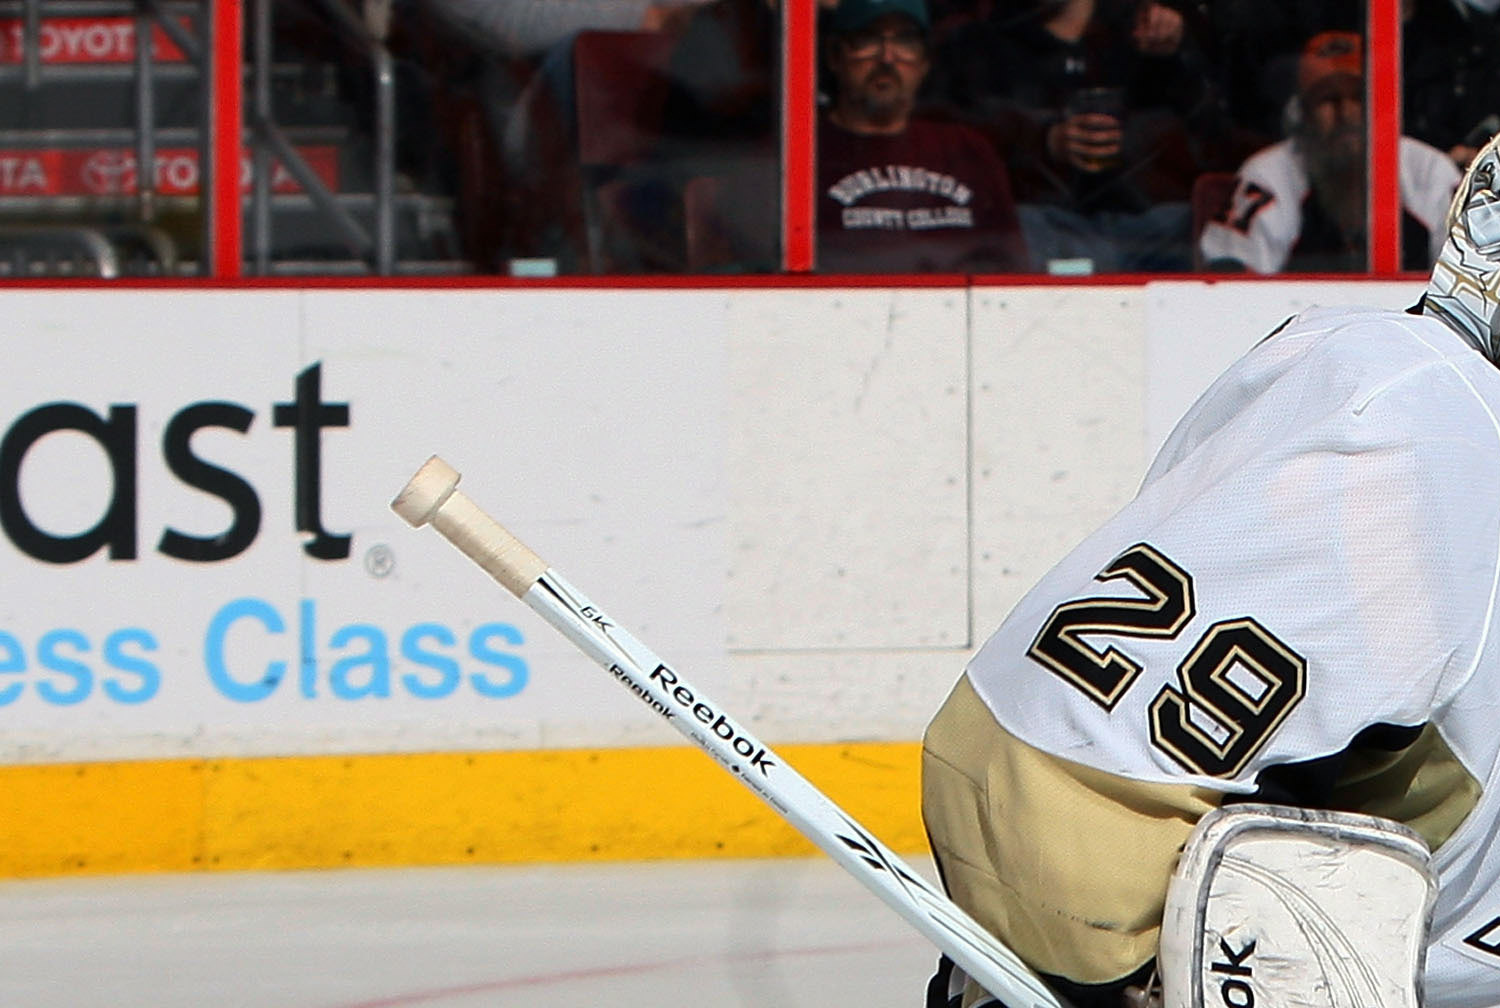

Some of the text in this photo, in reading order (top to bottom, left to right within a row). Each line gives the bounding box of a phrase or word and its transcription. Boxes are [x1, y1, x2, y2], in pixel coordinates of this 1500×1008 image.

[12, 23, 156, 57] TOYOT
[204, 598, 530, 702] Class
[609, 663, 677, 721] Reebok
[1025, 541, 1308, 779] 29
[649, 663, 777, 778] Reebok
